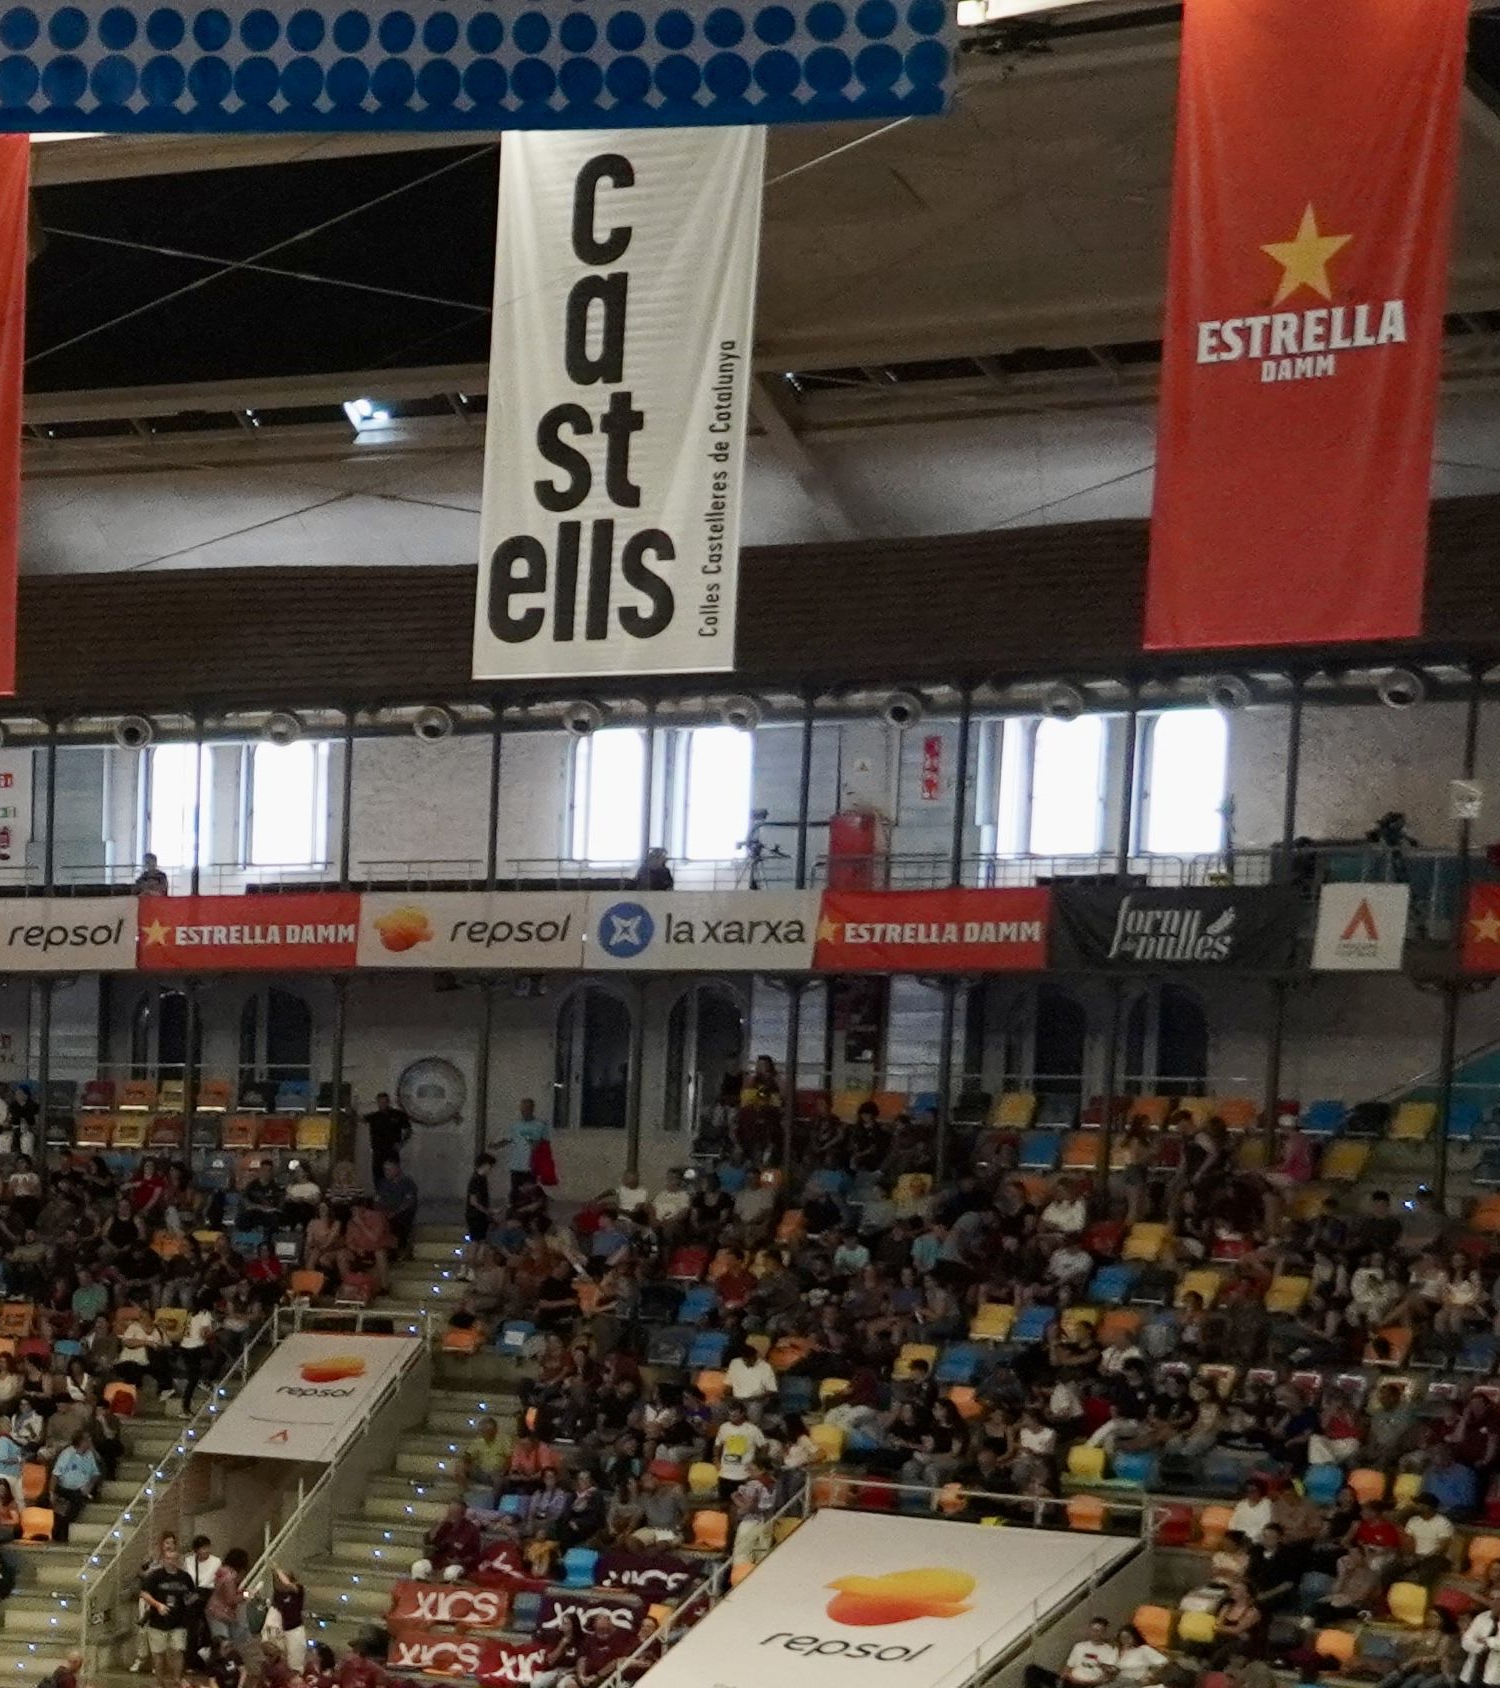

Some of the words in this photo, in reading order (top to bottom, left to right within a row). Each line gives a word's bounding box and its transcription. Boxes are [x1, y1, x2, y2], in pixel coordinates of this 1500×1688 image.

[1195, 300, 1406, 366] ESTRELLA
[1260, 351, 1336, 385] DAMM
[709, 338, 737, 435] Catalunya
[711, 439, 731, 464] de
[703, 470, 730, 575] Castelleres
[697, 581, 721, 640] Colles
[7, 918, 125, 951] repsol
[174, 924, 281, 946] ESTRELLA
[285, 922, 356, 945] DAMM
[450, 913, 573, 948] repsol
[665, 912, 694, 945] la
[699, 916, 806, 946] xarxa
[843, 920, 960, 946] ESTRELLA
[964, 918, 1043, 945] DAMM
[275, 1383, 356, 1400] repsol
[405, 1589, 501, 1622] XICS
[758, 1631, 937, 1665] repsol
